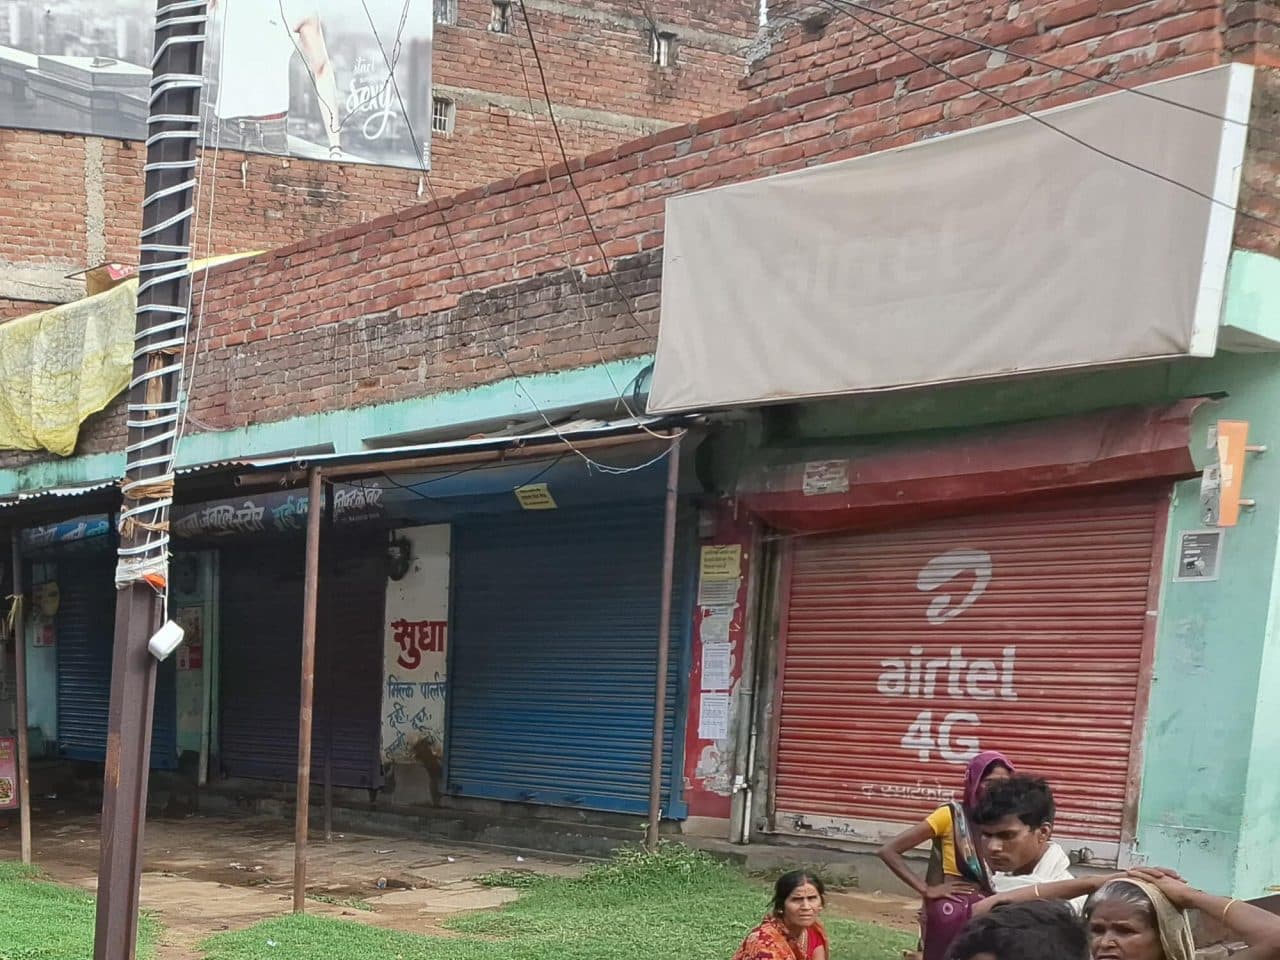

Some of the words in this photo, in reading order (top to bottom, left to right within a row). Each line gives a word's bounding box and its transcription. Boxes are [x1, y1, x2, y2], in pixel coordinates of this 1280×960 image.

[391, 618, 448, 669] सुधा
[387, 674, 417, 701] मिल्क
[876, 645, 1018, 701] airtel
[900, 710, 981, 764] 4G
